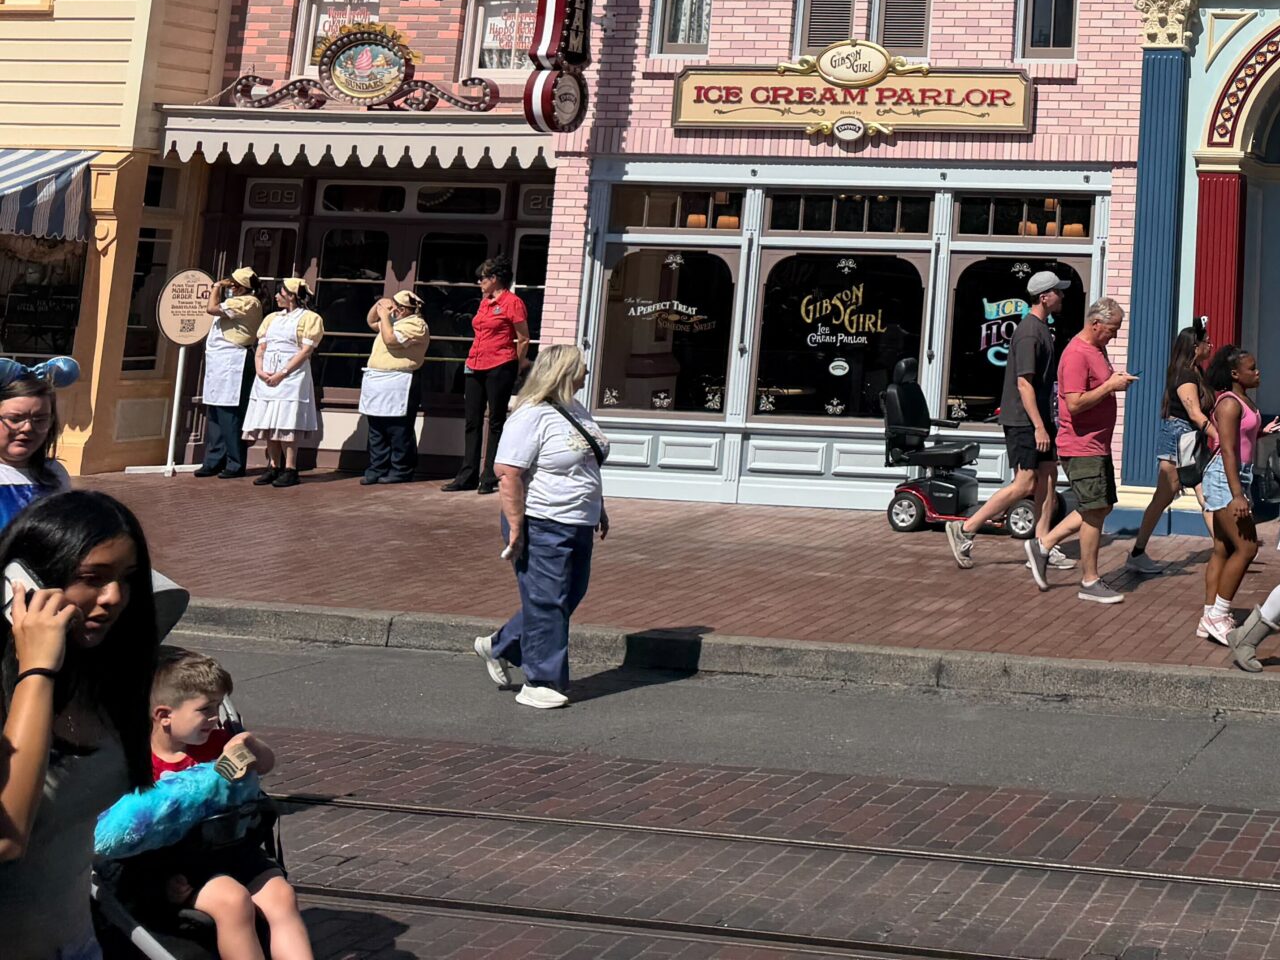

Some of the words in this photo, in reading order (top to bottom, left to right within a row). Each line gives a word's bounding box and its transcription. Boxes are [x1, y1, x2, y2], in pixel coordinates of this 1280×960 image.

[831, 49, 862, 69] GIBSON
[852, 60, 873, 73] GIRL
[345, 79, 384, 90] SUNDAES
[693, 85, 743, 104] ICE
[750, 85, 868, 106] CREAM
[875, 87, 1015, 107] PARLOR
[254, 189, 296, 203] 209
[530, 195, 553, 209] 20
[628, 307, 636, 316] A
[637, 301, 671, 316] PERFECT
[672, 300, 698, 315] TREAT
[801, 283, 864, 324] GIBSON
[995, 300, 1023, 318] ICE
[844, 305, 888, 333] GIRL
